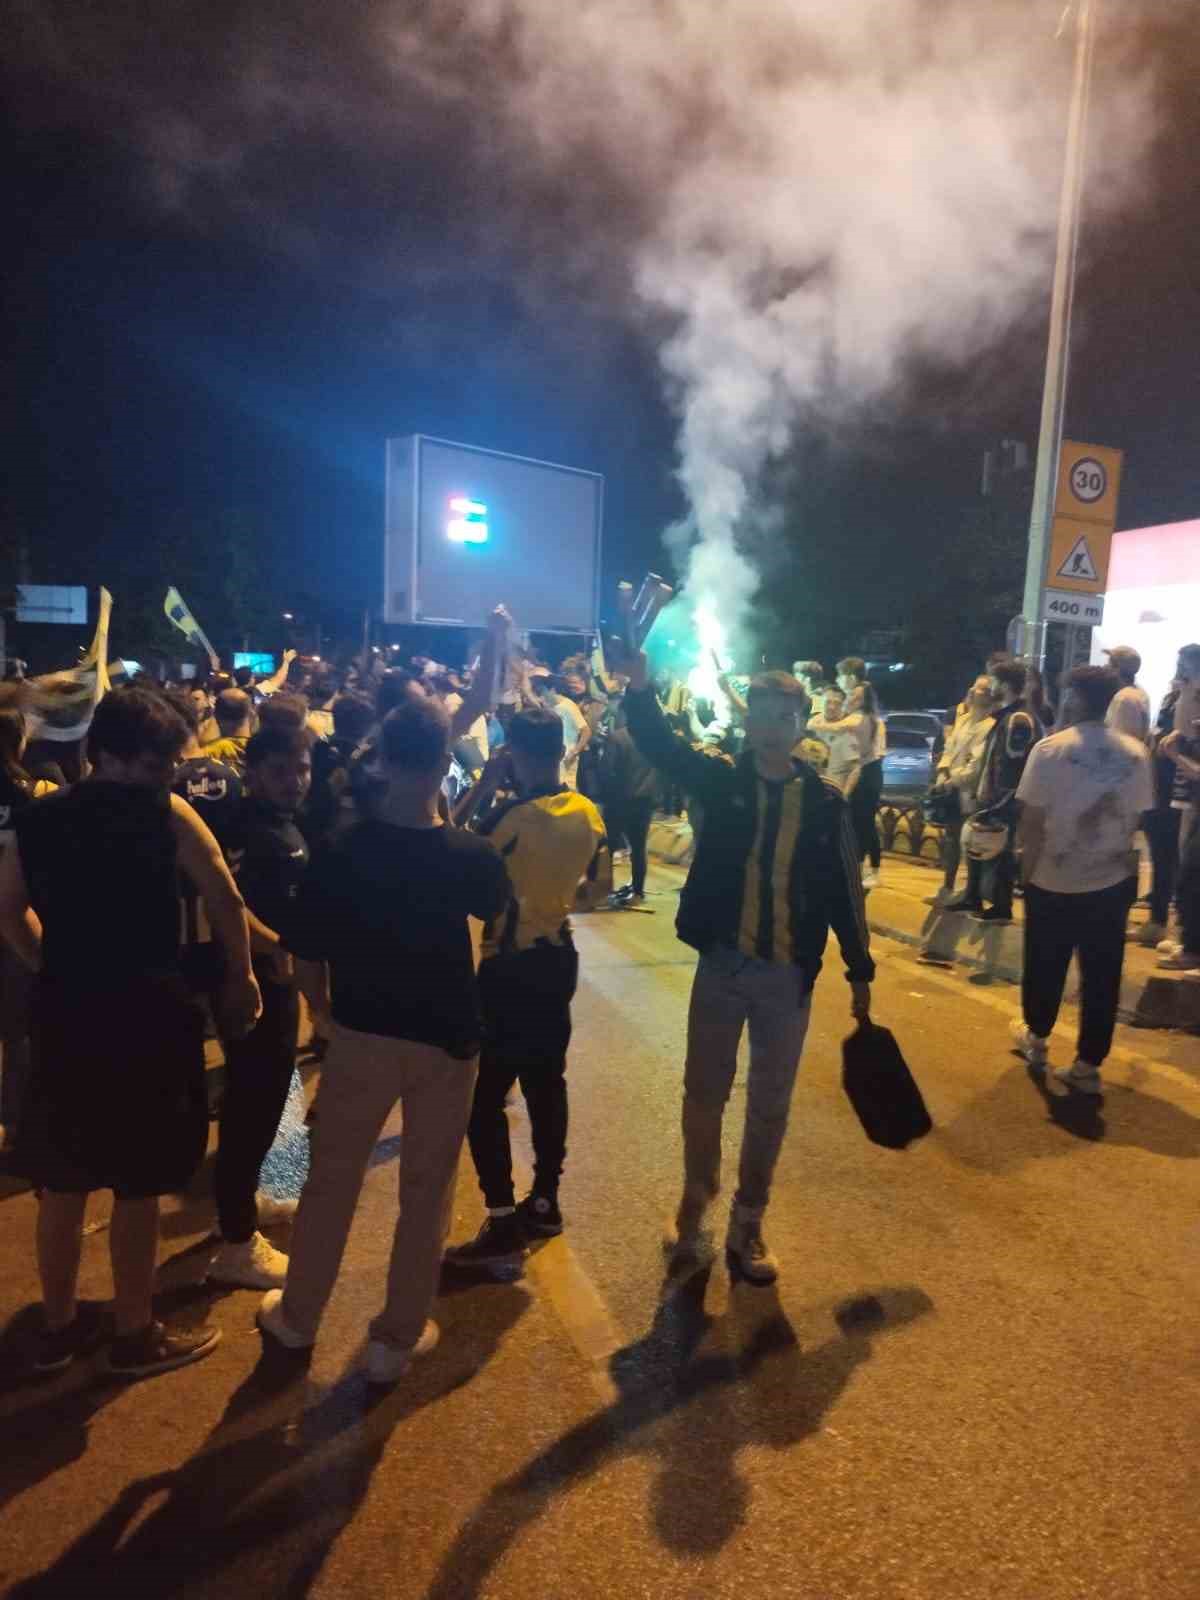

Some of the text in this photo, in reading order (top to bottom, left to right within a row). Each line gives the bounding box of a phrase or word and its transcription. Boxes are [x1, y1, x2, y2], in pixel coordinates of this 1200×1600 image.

[1076, 471, 1101, 490] 30
[1049, 600, 1099, 617] 400 m
